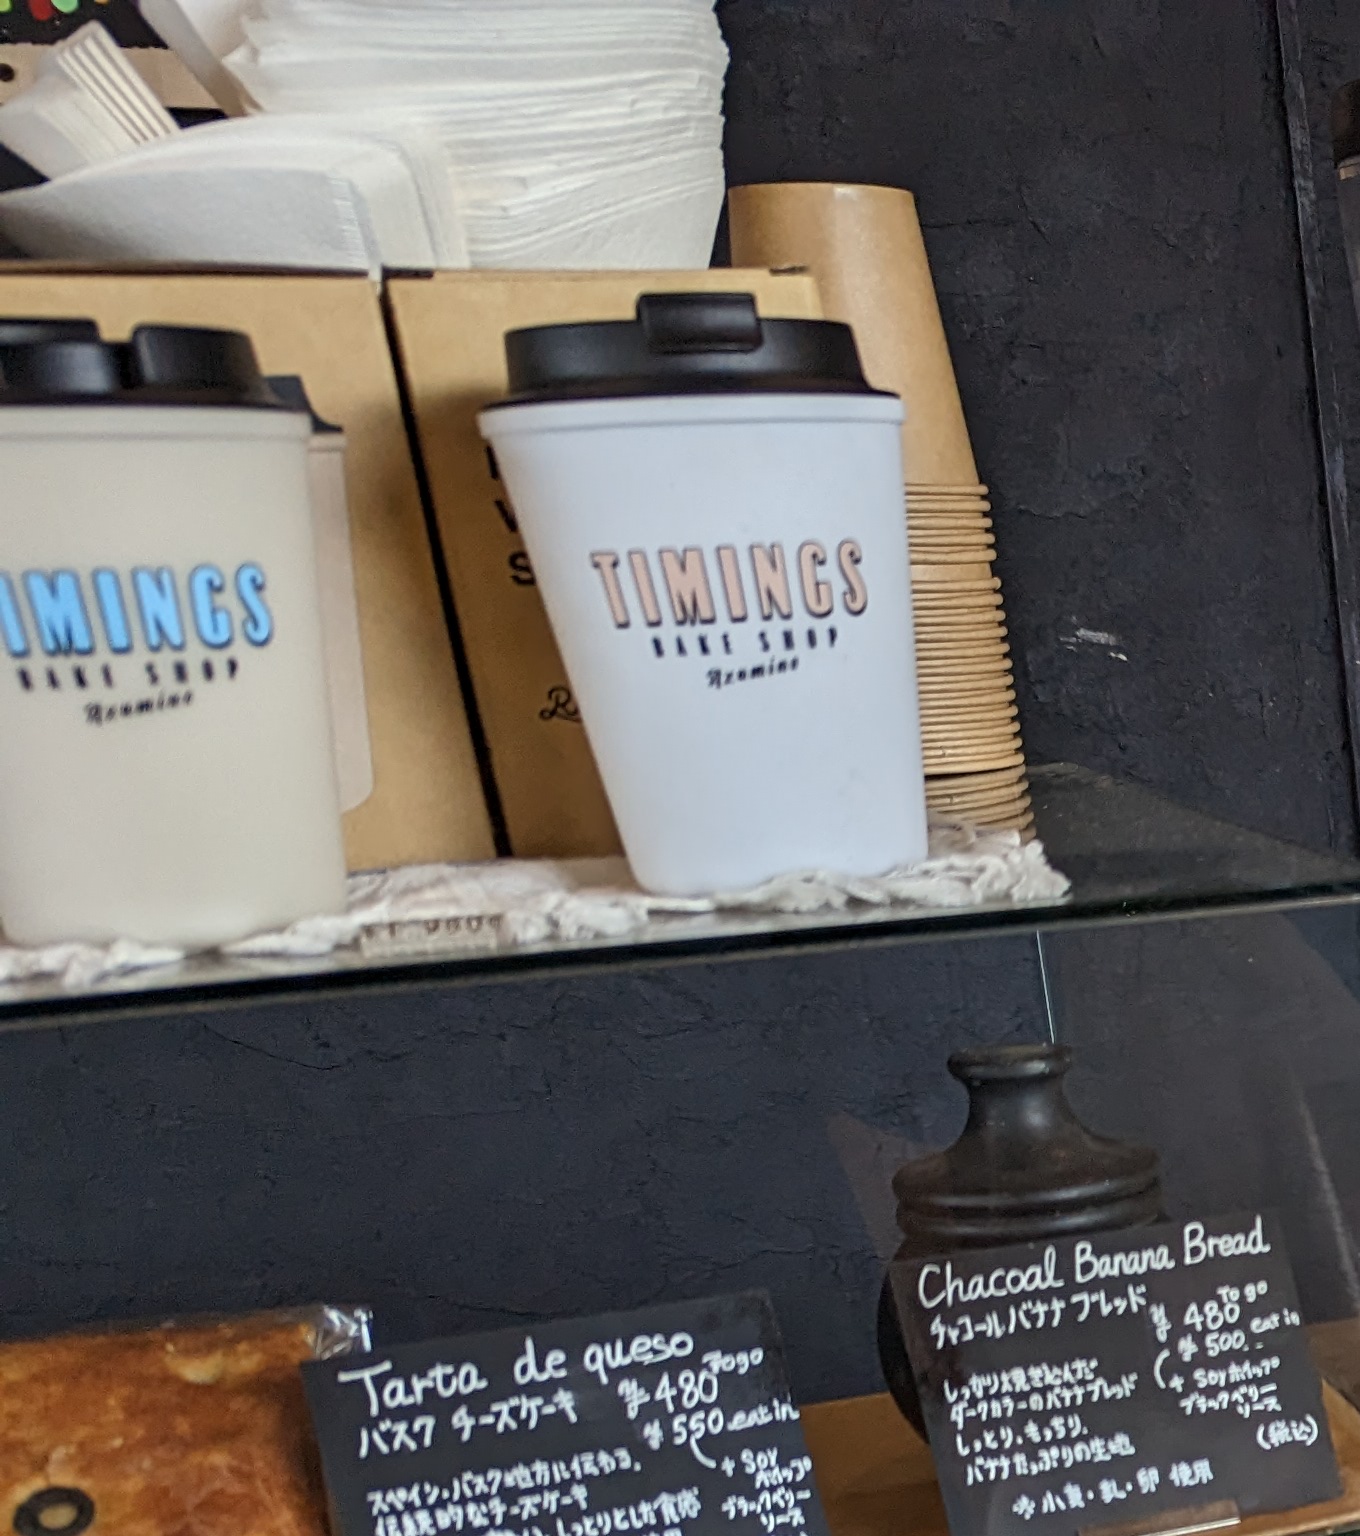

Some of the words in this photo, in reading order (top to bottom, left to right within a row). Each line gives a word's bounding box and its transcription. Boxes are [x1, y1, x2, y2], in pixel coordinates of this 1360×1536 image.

[0, 562, 275, 659] IMINGS
[589, 536, 869, 630] TIMINGS
[918, 1245, 1064, 1310] Chacoal
[1074, 1240, 1177, 1285] Banana
[1184, 1214, 1272, 1267] Bread
[338, 1360, 489, 1418] Tarta
[512, 1335, 568, 1386] de
[583, 1330, 695, 1386] queso
[358, 1412, 436, 1459] バスク
[451, 1387, 579, 1444] チーズケーキ
